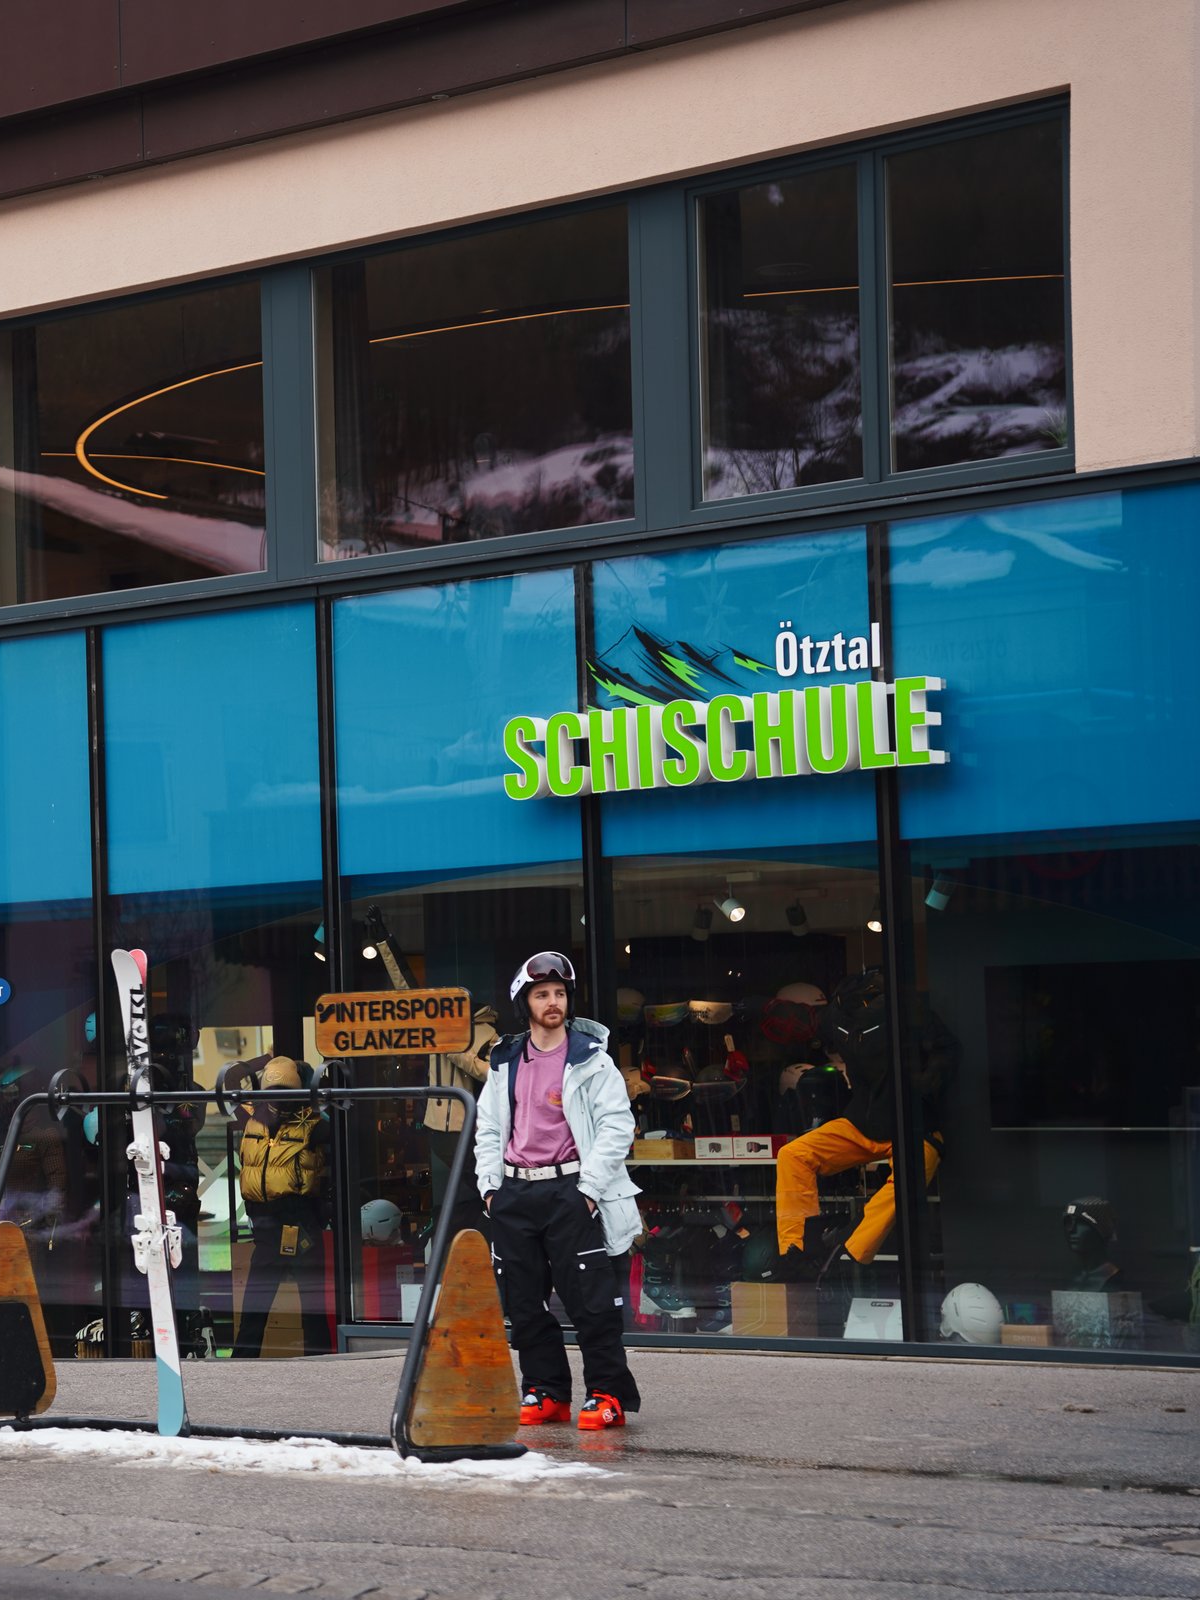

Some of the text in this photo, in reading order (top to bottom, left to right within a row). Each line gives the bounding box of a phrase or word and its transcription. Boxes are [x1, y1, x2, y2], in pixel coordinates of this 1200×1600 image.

[775, 620, 882, 677] Ötztal
[503, 676, 933, 800] SCHISCHULE
[335, 997, 467, 1023] INTERSPORT
[334, 1028, 437, 1051] GLANZER
